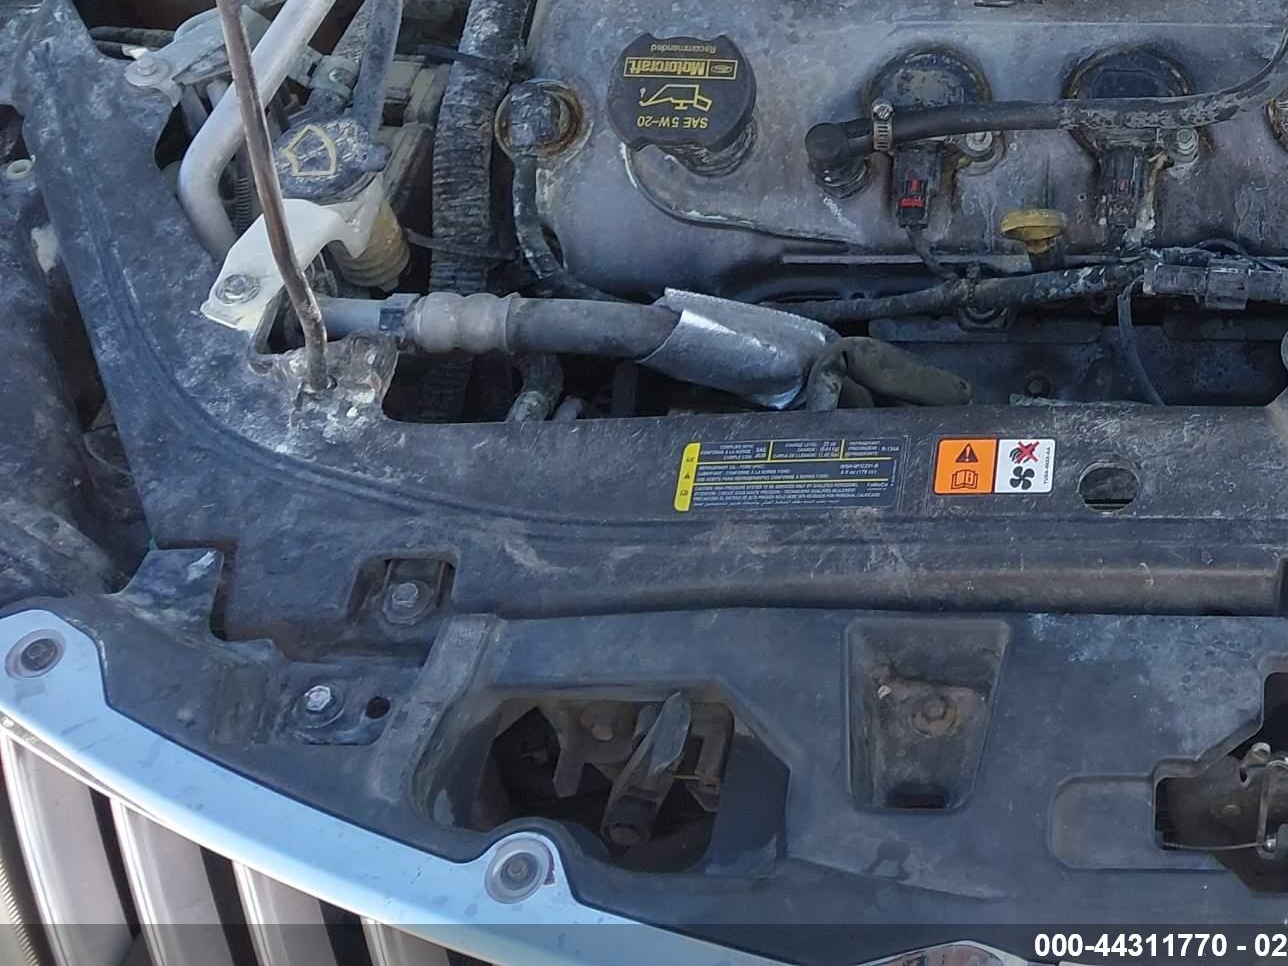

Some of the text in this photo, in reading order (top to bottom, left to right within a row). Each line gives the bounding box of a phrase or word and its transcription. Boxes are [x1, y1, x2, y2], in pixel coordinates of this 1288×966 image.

[650, 43, 717, 54] Recommended
[628, 59, 706, 75] Motorcraft
[636, 115, 709, 128] SAE 5W-20
